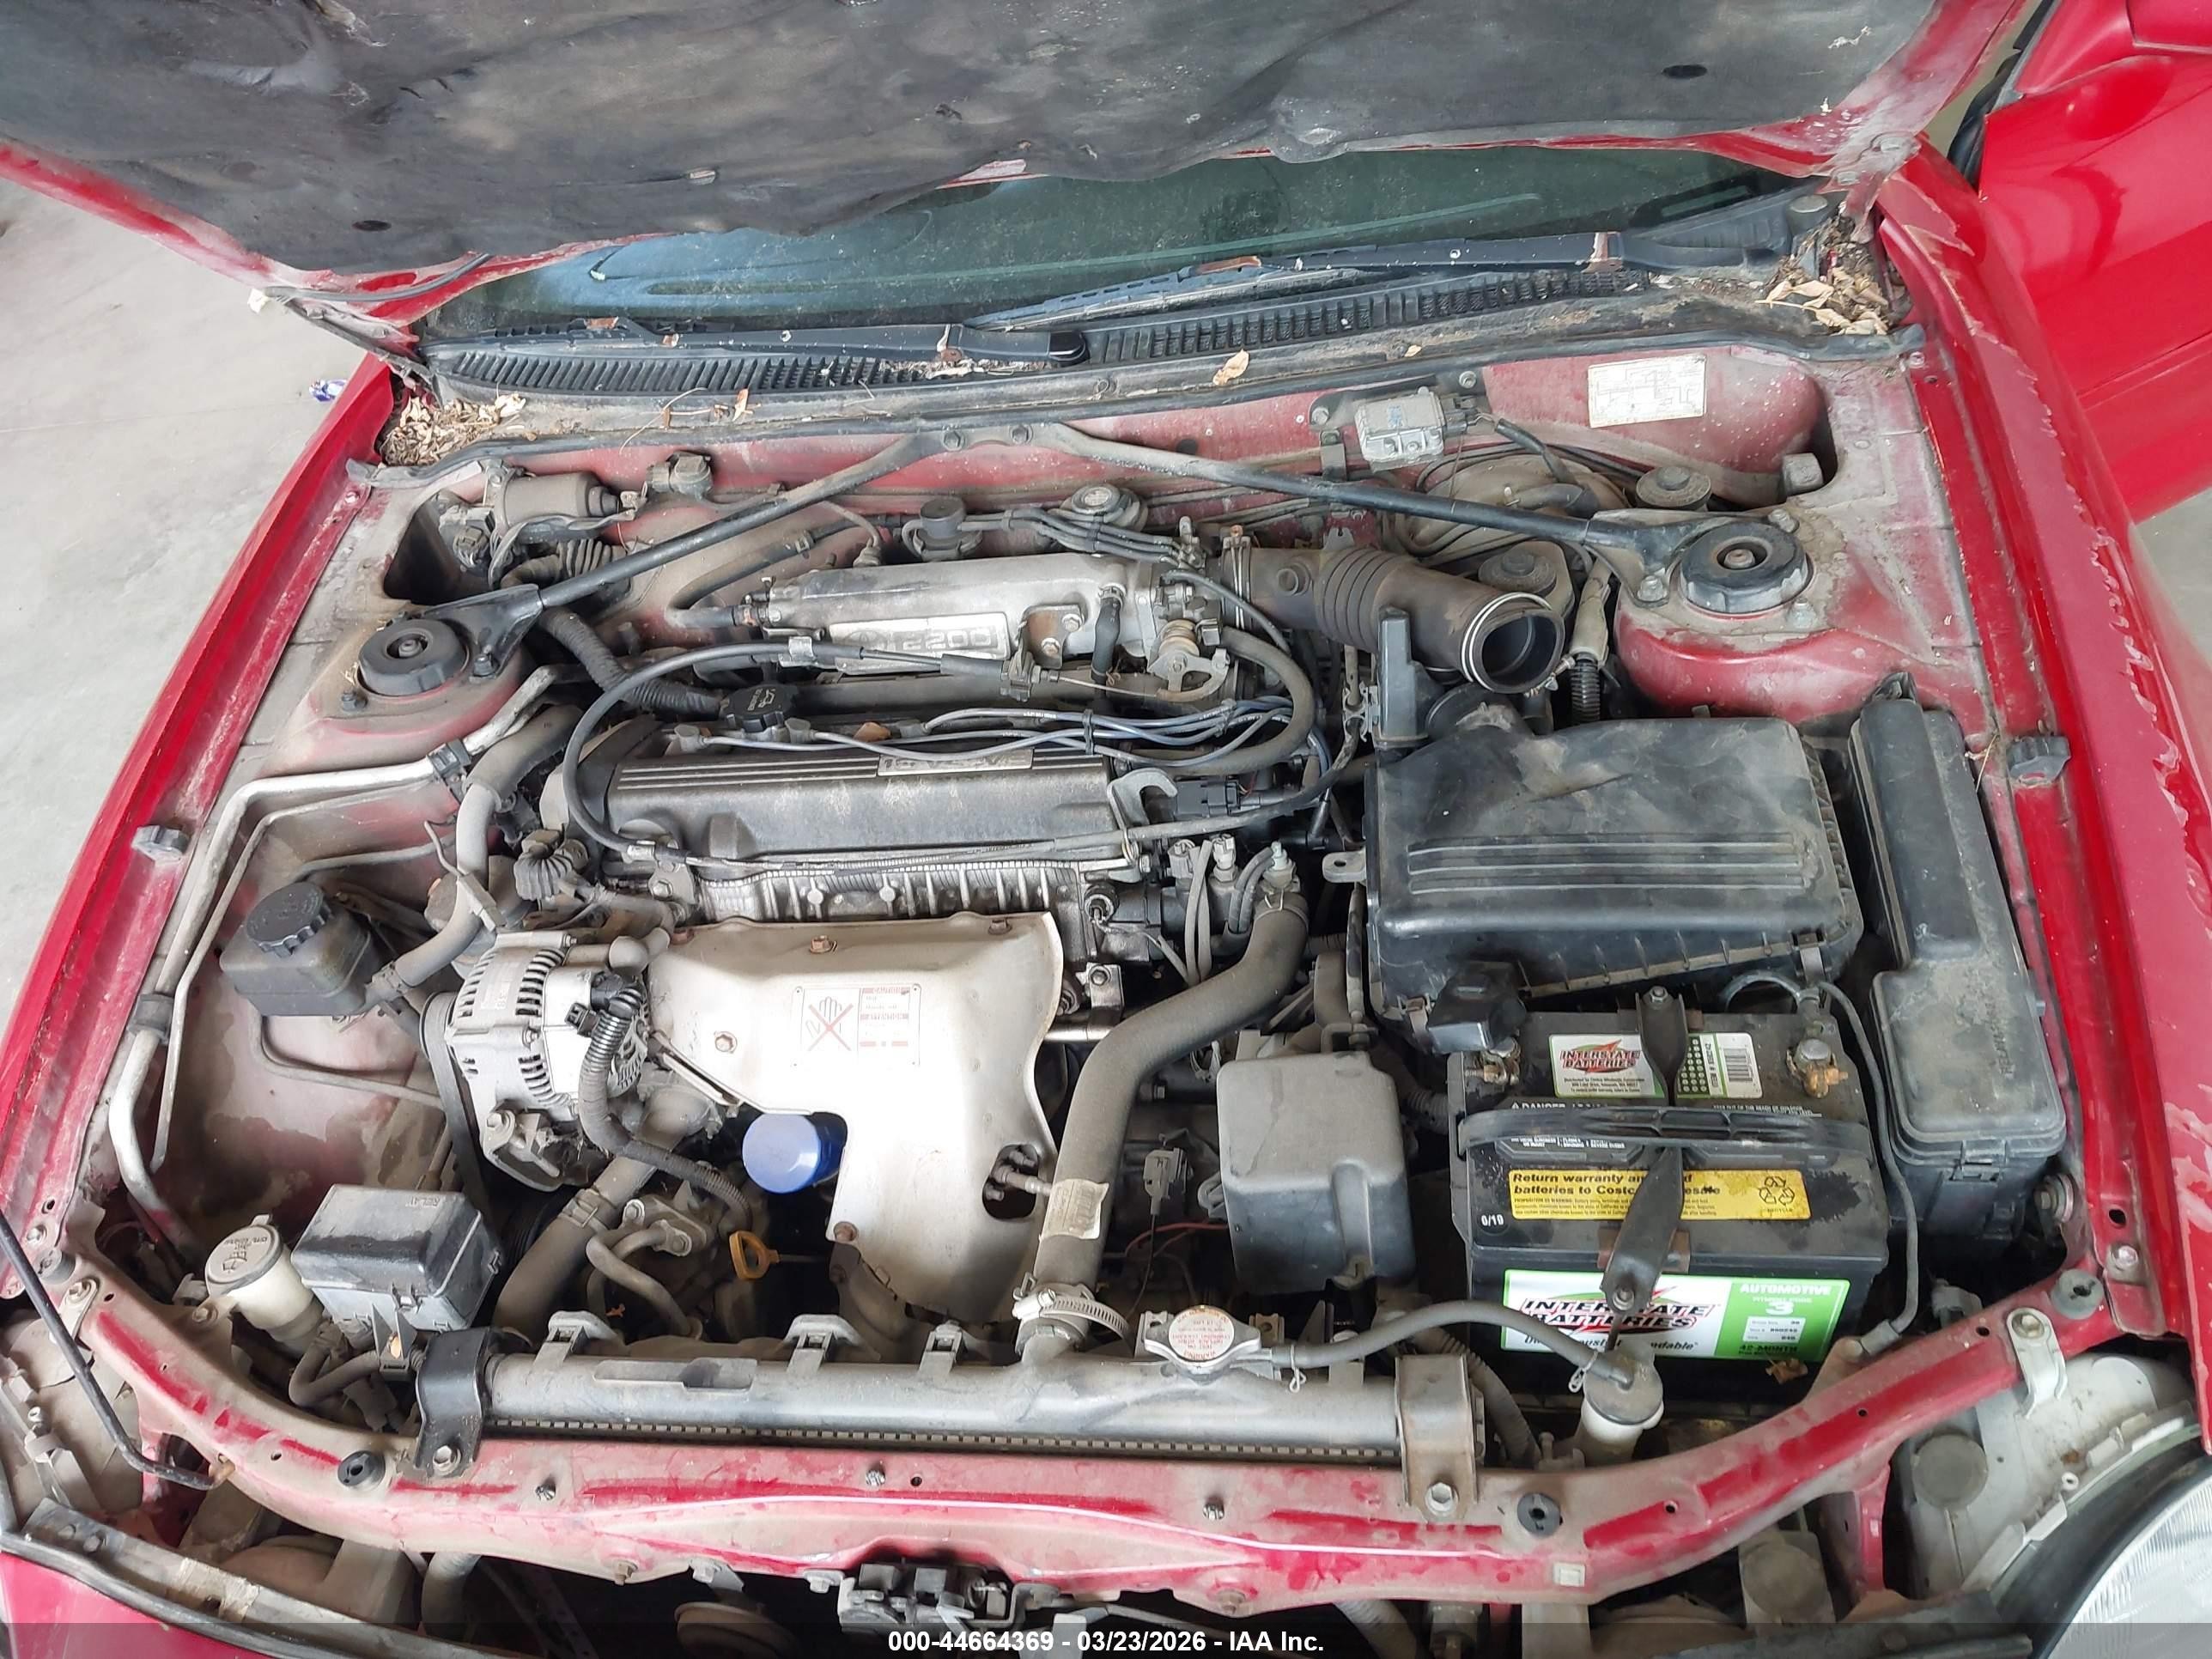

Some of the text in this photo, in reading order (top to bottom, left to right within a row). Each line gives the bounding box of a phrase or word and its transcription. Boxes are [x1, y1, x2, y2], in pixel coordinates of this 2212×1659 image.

[1559, 1049, 1641, 1061] INTERSTATE
[1562, 1058, 1637, 1069] BATTERIES
[1513, 1173, 1559, 1183] Return
[1564, 1173, 1624, 1185] warranty
[1514, 1185, 1637, 1195] batteries to Costc
[1740, 1282, 1832, 1296] AUTOMOTIVE
[1523, 1299, 1711, 1316] INTERATE
[1765, 1300, 1796, 1316] 3
